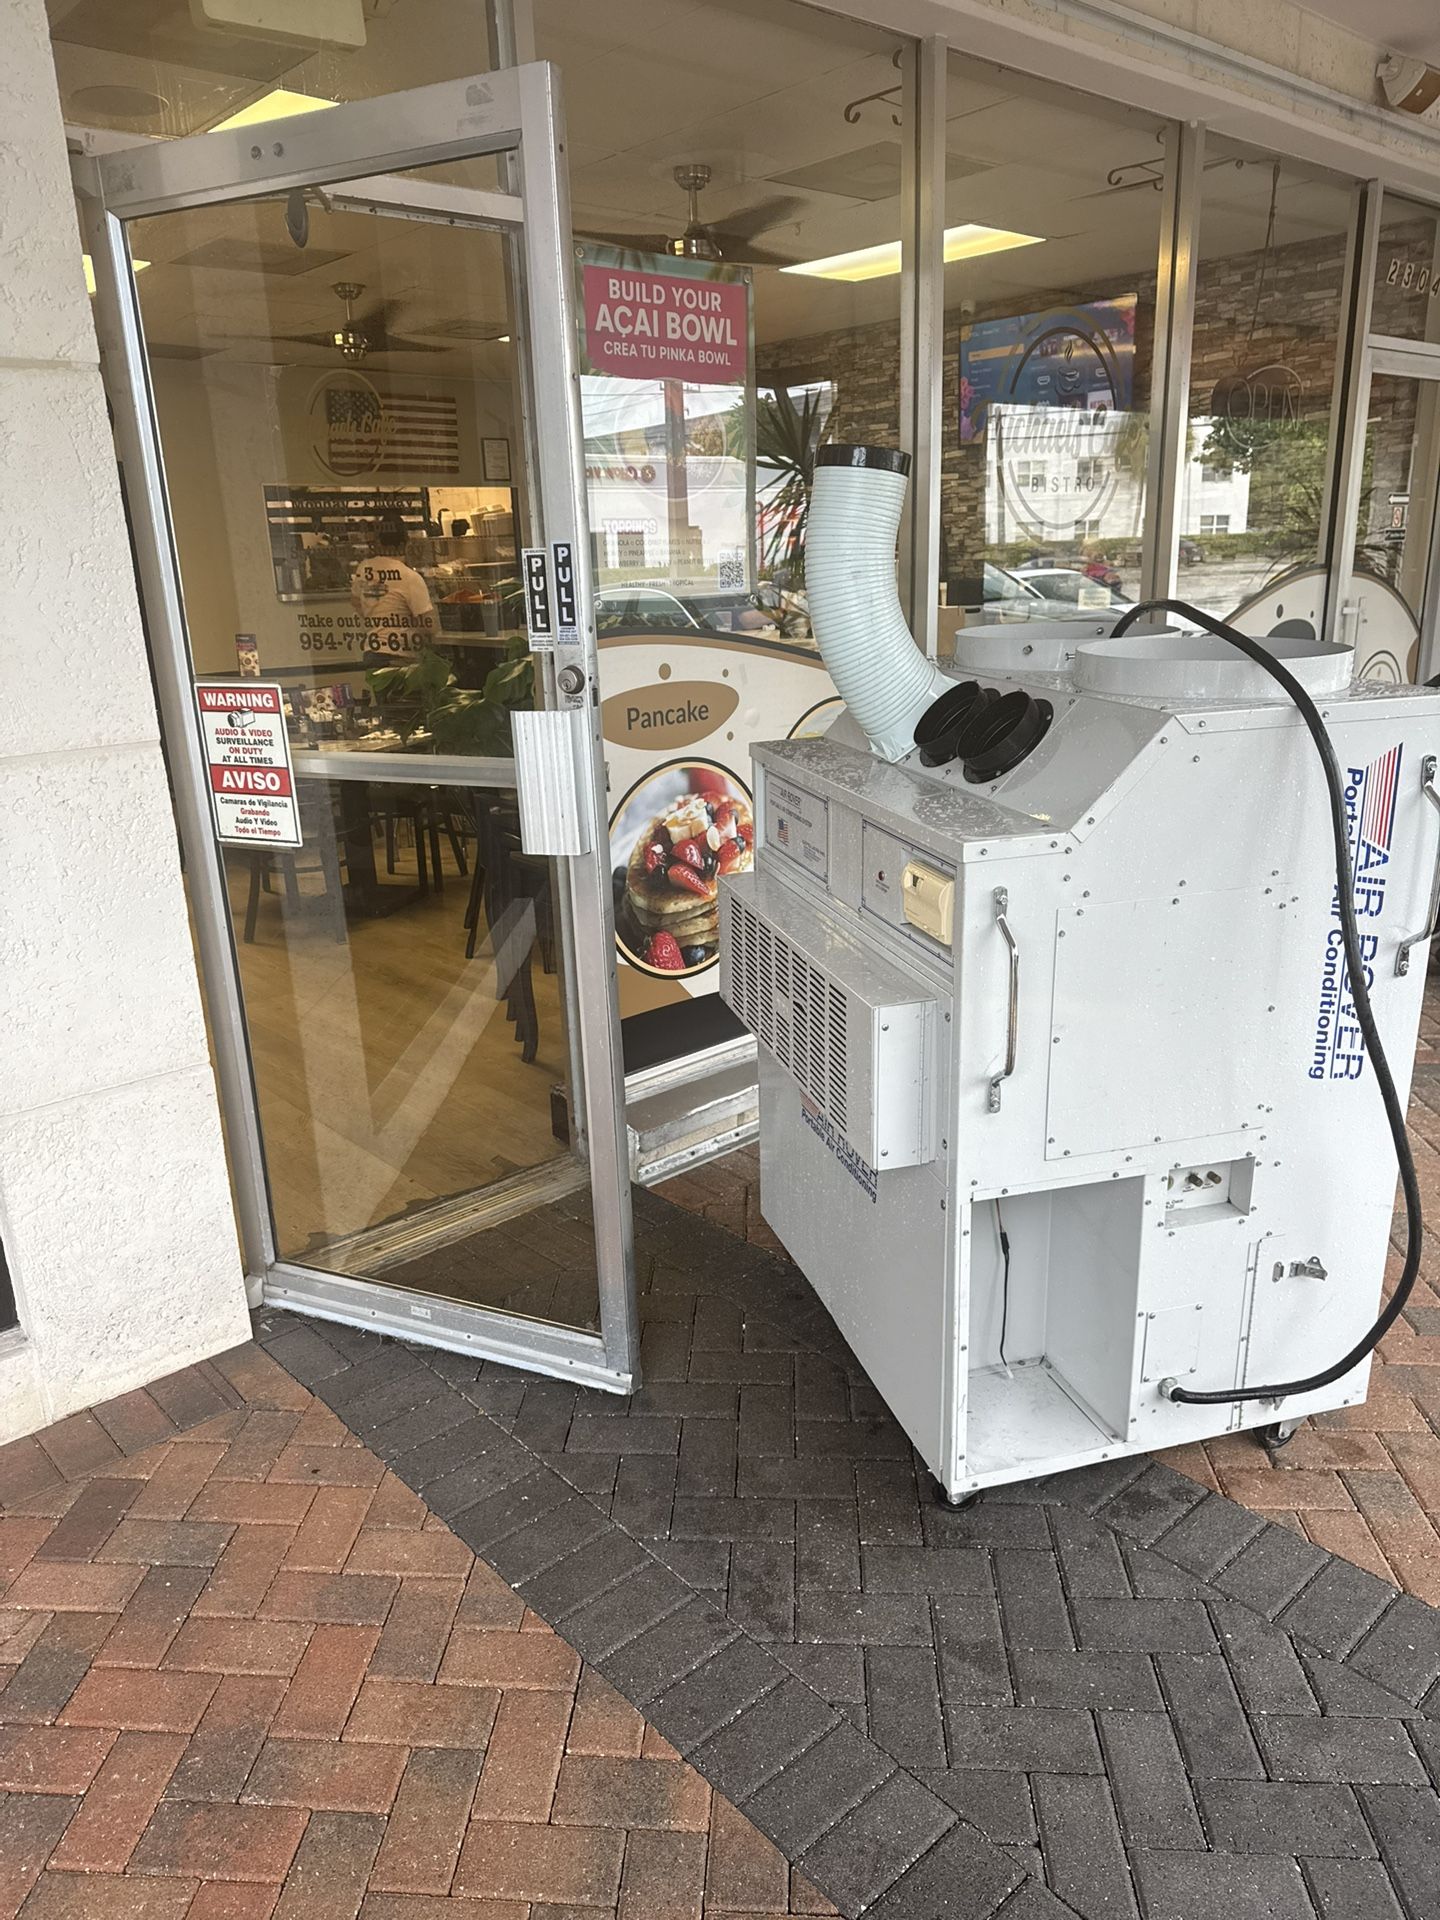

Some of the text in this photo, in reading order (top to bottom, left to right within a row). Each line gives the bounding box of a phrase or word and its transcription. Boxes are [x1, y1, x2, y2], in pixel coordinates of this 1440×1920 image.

[1388, 261, 1440, 296] 2304
[608, 278, 722, 312] BUILD YOUR
[595, 304, 737, 346] AÇAI BOWL
[603, 341, 731, 366] CREA TU PINKA BOWL
[1226, 379, 1300, 433] OPEN
[1031, 475, 1095, 493] BISTRO
[602, 519, 657, 534] TOPPINGS
[364, 567, 374, 581] 3
[379, 568, 402, 583] pm
[531, 557, 547, 628] PULL
[557, 547, 573, 622] PULL
[298, 613, 433, 628] Take out available
[203, 692, 274, 709] WARNING
[626, 699, 710, 730] Pancake
[215, 728, 239, 736] AUDIO
[248, 729, 273, 737] VIDEO
[216, 737, 274, 747] SURVEILLANCE
[229, 747, 263, 755] ON DUTY
[222, 755, 274, 765] AT ALL TIMES
[222, 770, 281, 791] AVISO
[220, 797, 247, 806] Camaras
[258, 799, 288, 809] Vigilancia
[235, 816, 278, 826] Audio Y Video
[240, 808, 270, 817] Grabando
[235, 826, 281, 836] Todo el Tiempo
[1354, 839, 1389, 917] AIR
[1308, 929, 1343, 1080] Conditioning
[836, 1147, 877, 1204] Conditioning
